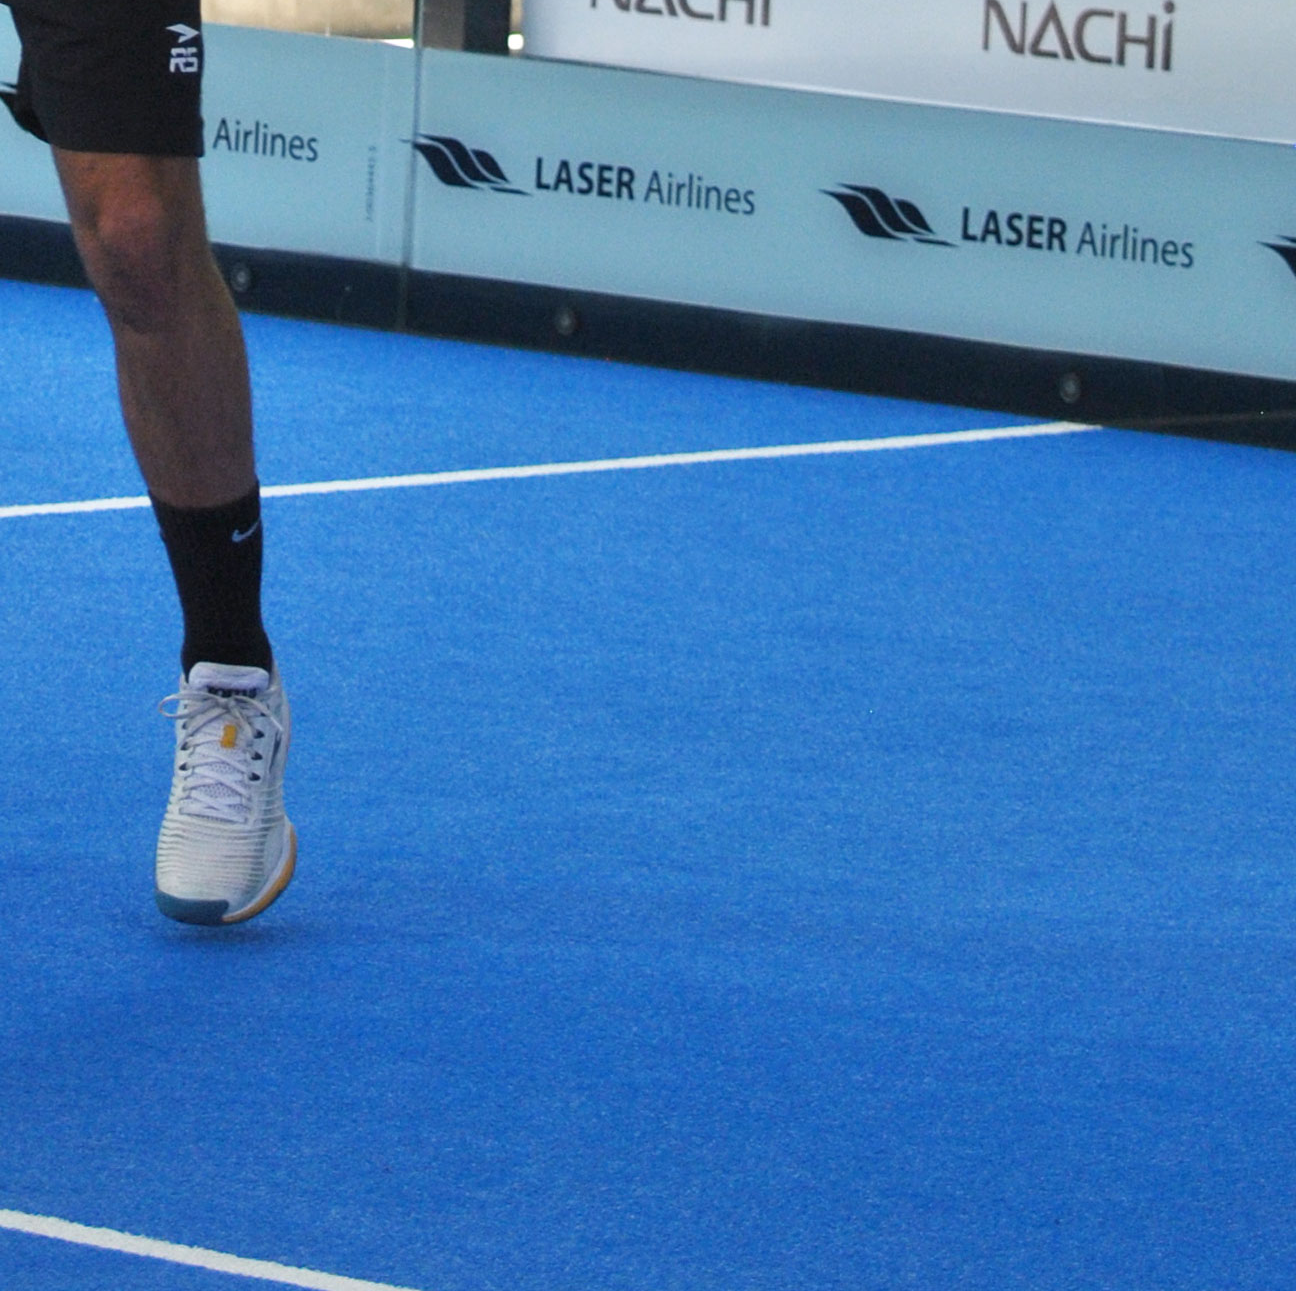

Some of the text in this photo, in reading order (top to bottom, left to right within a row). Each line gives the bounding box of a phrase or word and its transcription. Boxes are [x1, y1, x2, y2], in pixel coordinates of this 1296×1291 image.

[212, 117, 320, 163] Airlines
[535, 156, 757, 217] LASER Airlines
[960, 206, 1195, 269] LASER Airlines
